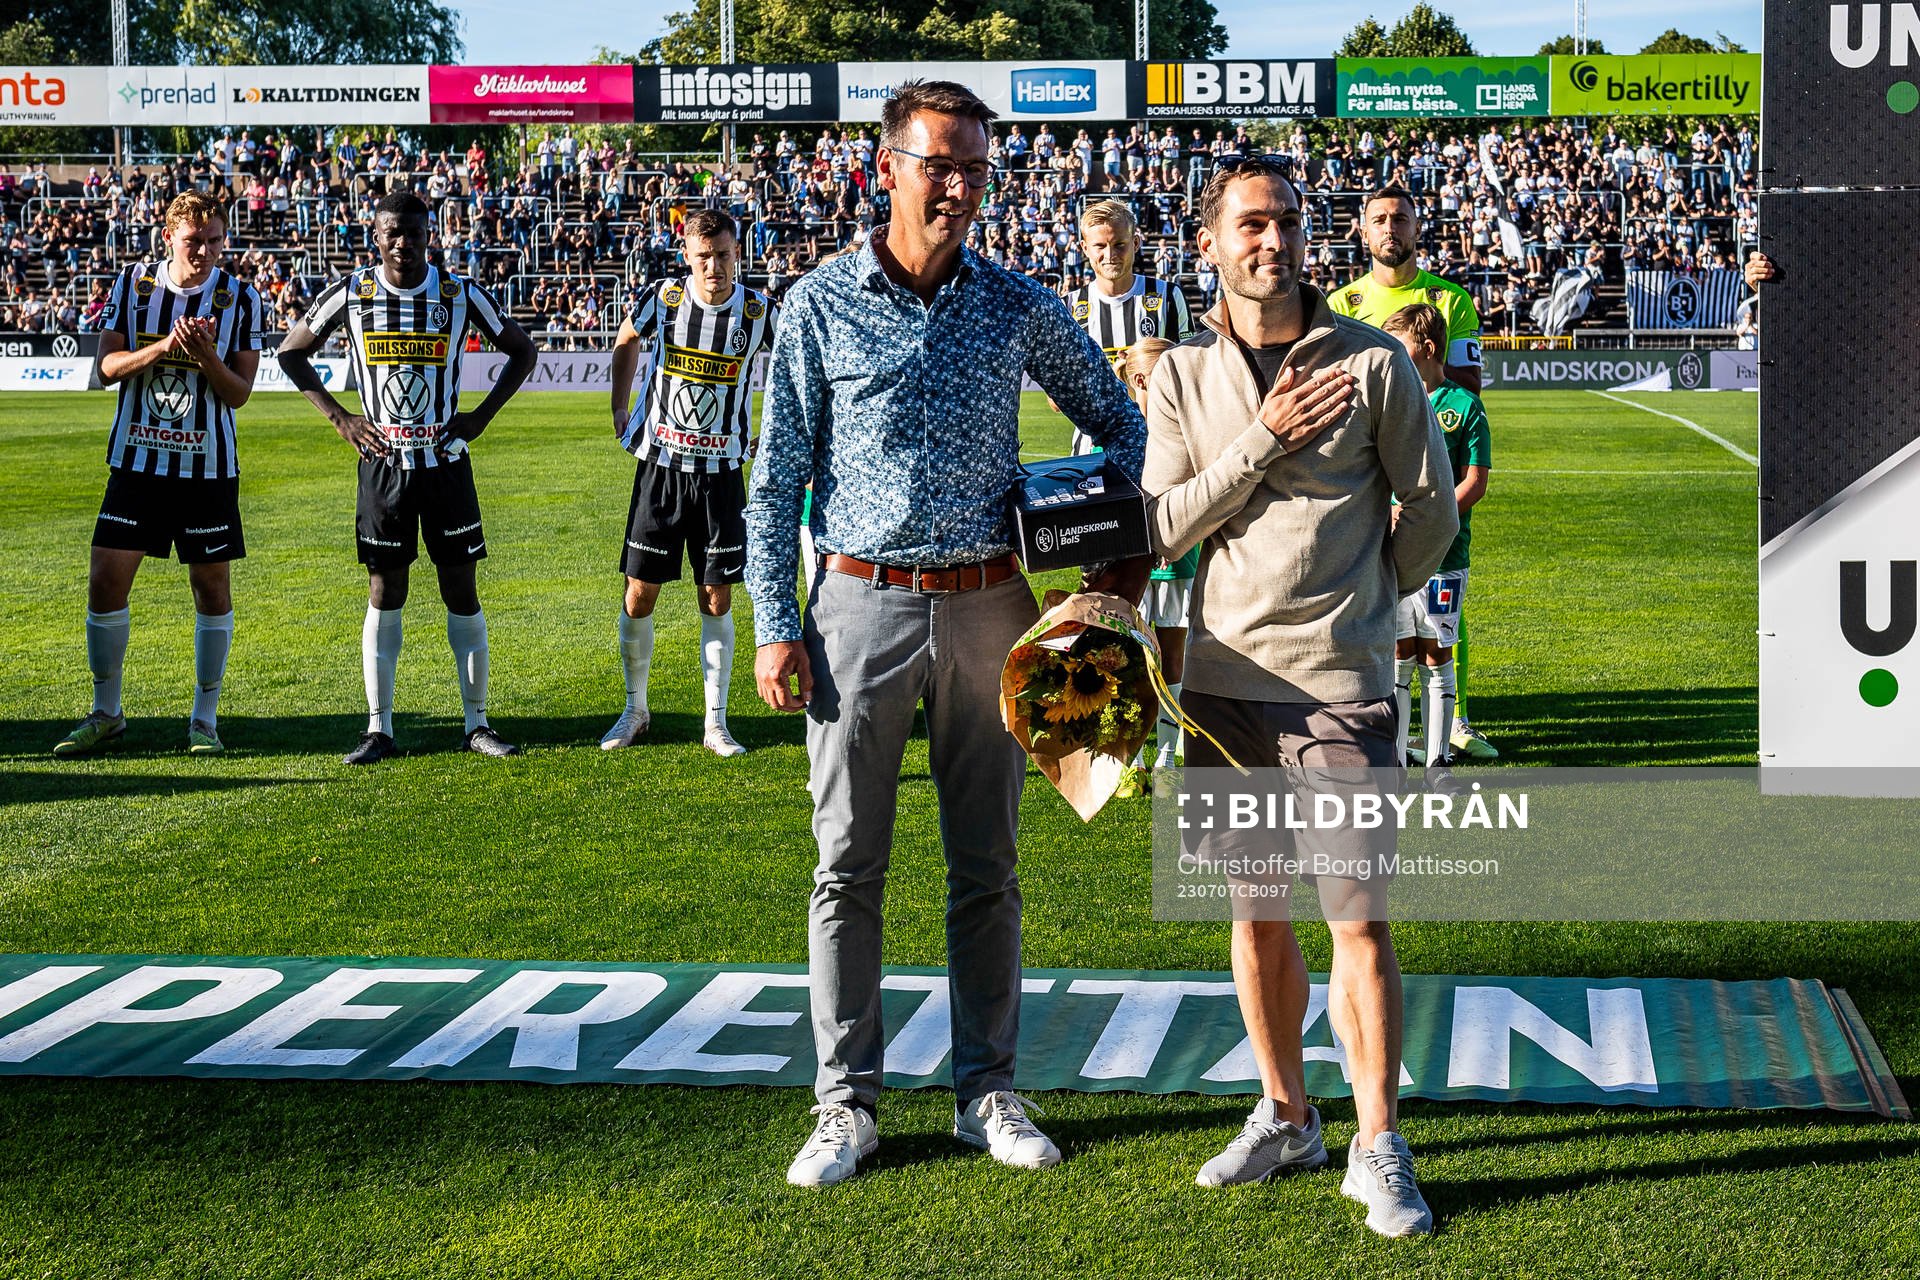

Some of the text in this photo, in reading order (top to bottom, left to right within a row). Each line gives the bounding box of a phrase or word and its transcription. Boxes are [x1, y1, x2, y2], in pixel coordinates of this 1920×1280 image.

[473, 74, 588, 97] Mäklarhuset
[659, 66, 812, 111] infosign
[1016, 79, 1092, 103] Haldex
[1183, 62, 1316, 104] BBM
[1347, 83, 1448, 98] Allmän nytta.
[1502, 84, 1537, 93] LANDS
[141, 82, 216, 109] prenad
[233, 87, 421, 103] LOKALTIDNINGEN
[1502, 92, 1539, 102] KRONA
[1146, 105, 1316, 116] BORSTAHUSENS BYGG & MONTAGE AB
[1347, 97, 1458, 112] För allas bästa.
[1502, 101, 1525, 110] HEM
[660, 109, 764, 123] Allt inom skyltar & print!
[368, 341, 434, 356] OHLSSONS
[667, 353, 728, 376] OHLSSONS
[1502, 361, 1667, 382] LANDSKRONA
[21, 368, 75, 380] SKF
[128, 424, 206, 444] FLYTGOLV
[656, 425, 729, 449] FLYTGOLV
[133, 438, 189, 452] LANDSKRONA
[658, 439, 714, 456] LANDSKRONA
[715, 449, 728, 457] AB
[1059, 519, 1119, 537] LANDSKRONA
